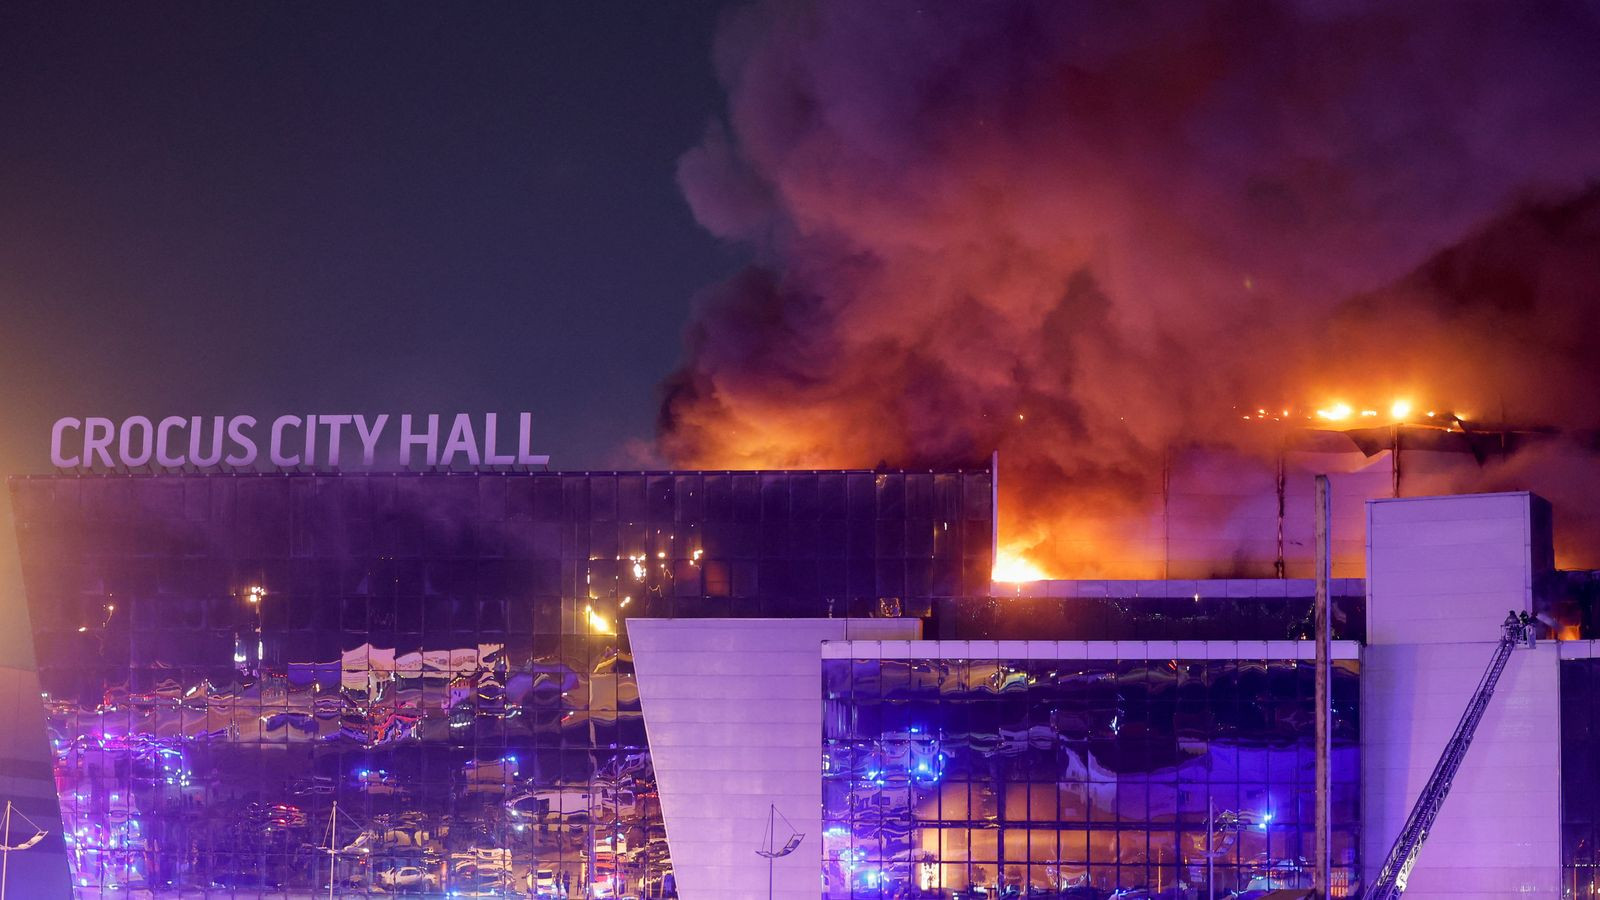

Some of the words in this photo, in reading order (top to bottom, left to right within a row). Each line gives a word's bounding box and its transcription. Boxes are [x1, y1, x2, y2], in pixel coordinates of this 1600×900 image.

[50, 414, 258, 468] CROCUS
[270, 413, 389, 467] CITY
[399, 412, 550, 466] HALL
